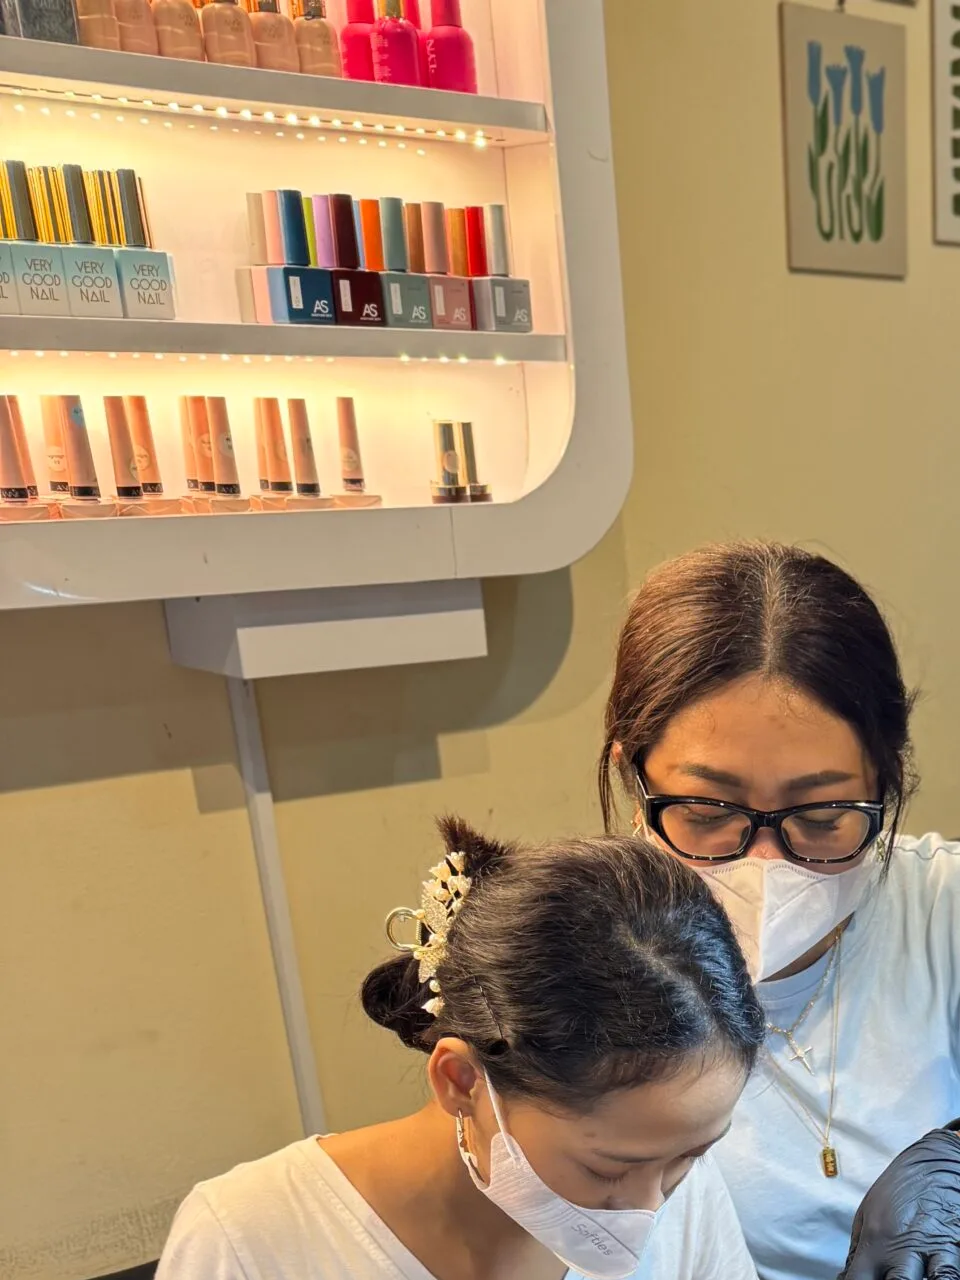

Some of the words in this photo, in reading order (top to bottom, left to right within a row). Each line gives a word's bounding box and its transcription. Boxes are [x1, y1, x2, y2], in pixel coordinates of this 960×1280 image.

[25, 257, 54, 272] VERY
[75, 260, 104, 274] VERY
[133, 264, 160, 277] VERY
[22, 272, 61, 286] GOOD
[71, 275, 112, 288] GOOD
[130, 278, 167, 291] GOOD
[313, 300, 329, 314] AS
[362, 303, 378, 317] AS
[411, 305, 426, 320] AS
[453, 307, 466, 321] AS
[513, 308, 528, 322] AS
[570, 1223, 613, 1256] Softies
